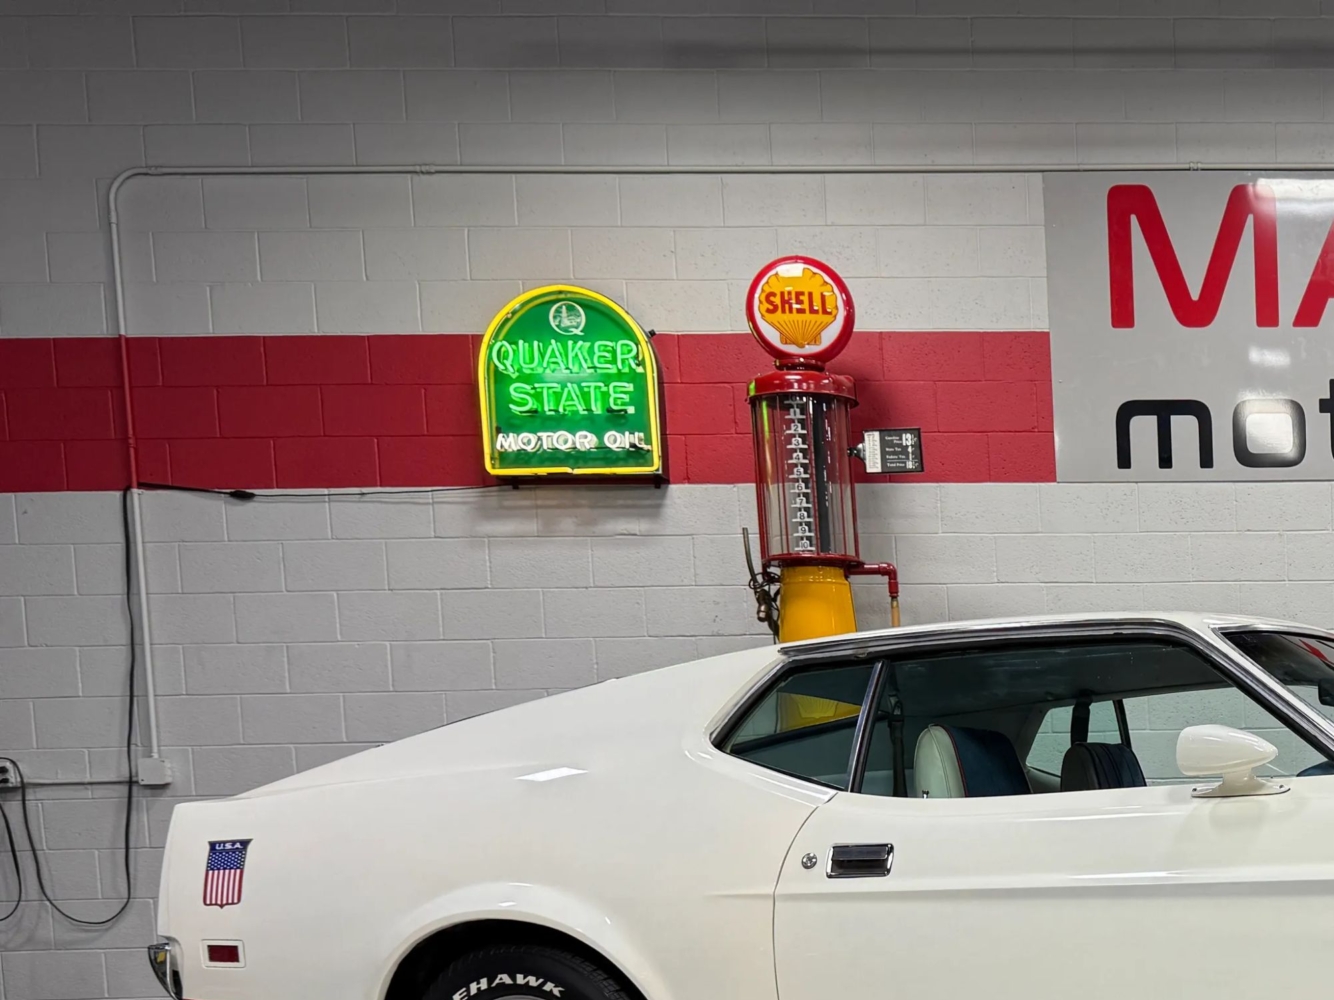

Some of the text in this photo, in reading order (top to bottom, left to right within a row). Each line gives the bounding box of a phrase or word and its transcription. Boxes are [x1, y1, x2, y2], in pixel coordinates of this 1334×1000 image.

[764, 291, 833, 316] SHELL
[491, 339, 645, 379] QUAKER
[508, 382, 635, 415] STATE
[793, 424, 799, 432] 2
[496, 430, 652, 452] MOTOR OIL
[794, 438, 800, 447] 3
[794, 453, 800, 461] 4
[795, 468, 802, 477] 5
[797, 482, 803, 491] 6
[799, 512, 805, 520] 8
[800, 526, 806, 534] 9
[800, 541, 808, 549] 10
[215, 842, 244, 850] U.S.A.
